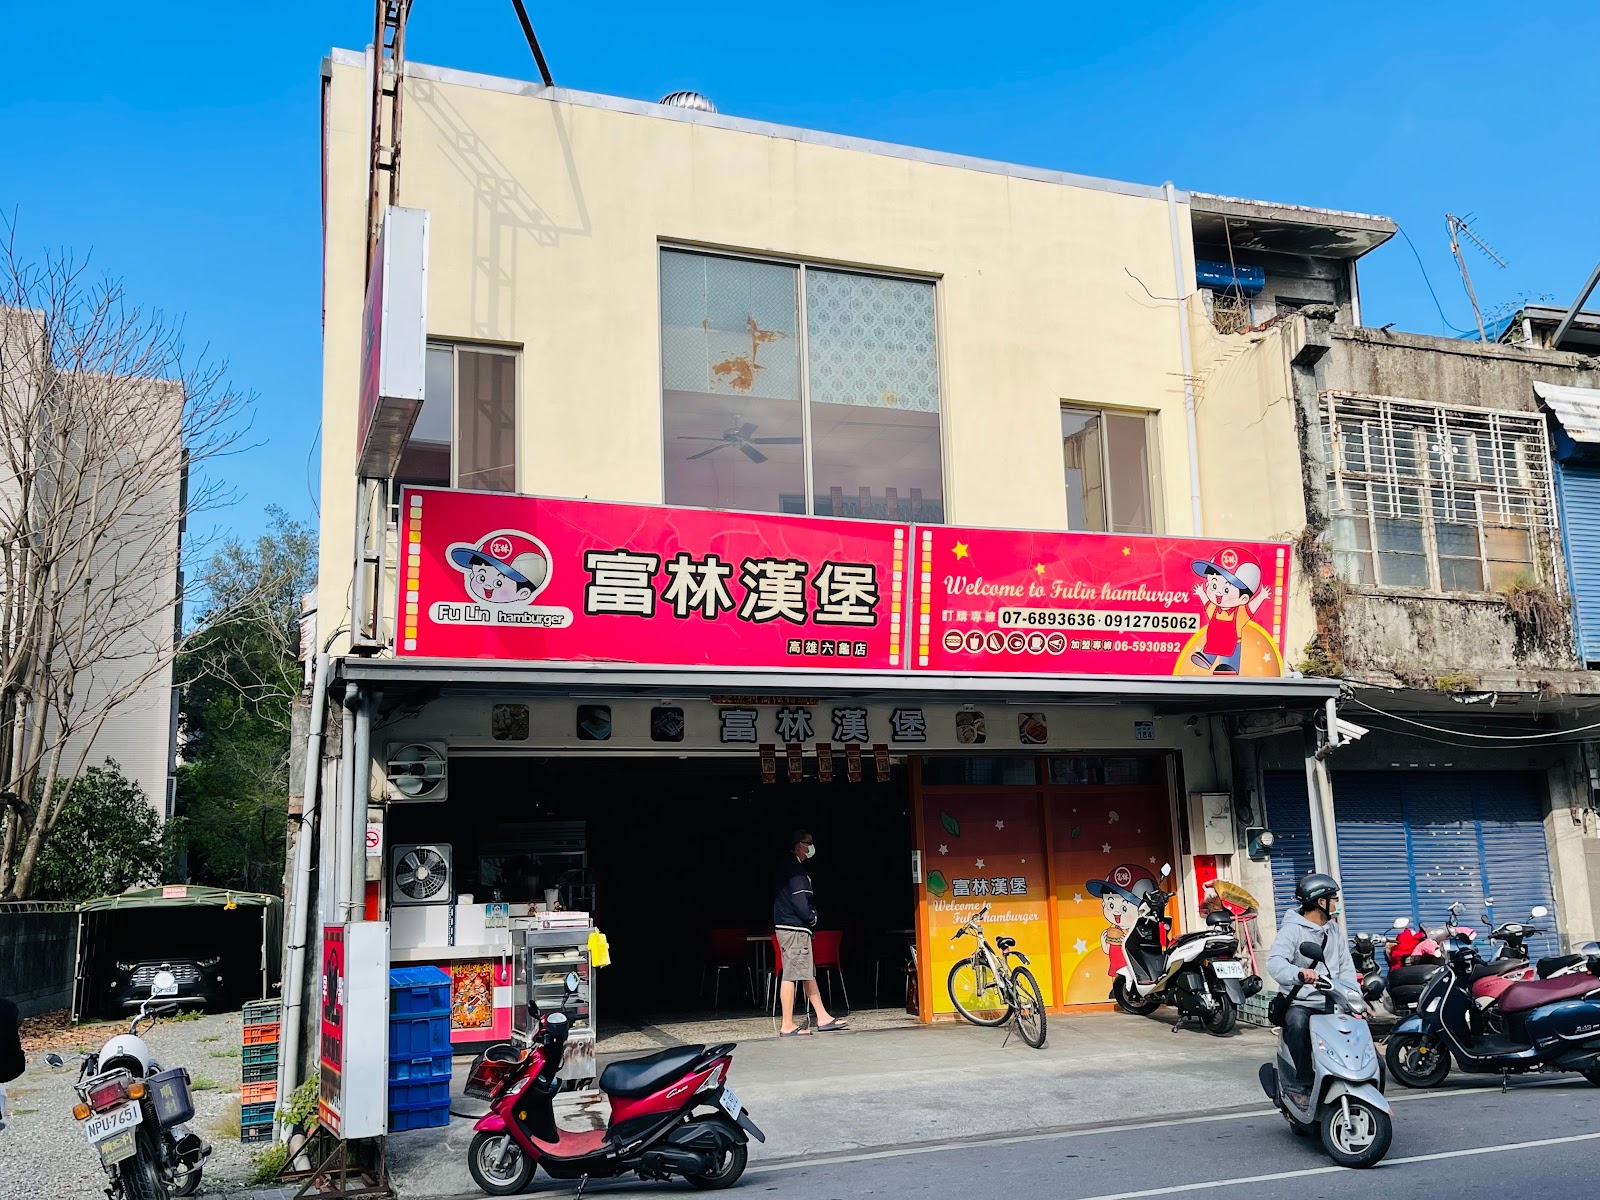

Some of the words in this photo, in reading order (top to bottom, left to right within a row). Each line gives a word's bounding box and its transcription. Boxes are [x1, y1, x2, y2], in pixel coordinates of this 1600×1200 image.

[584, 549, 881, 626] 富林漢堡
[943, 575, 1024, 598] Welcome
[1029, 580, 1045, 598] to
[1050, 580, 1097, 600] Fulin
[1101, 583, 1190, 608] hamburger
[436, 603, 460, 622] Fu
[464, 604, 491, 623] Lin
[497, 610, 565, 627] hamburger
[1114, 640, 1181, 653] 06-5930892
[719, 707, 927, 743] 富林漢堡
[1137, 731, 1152, 739] 184
[952, 877, 1028, 897] 富林漢堡
[933, 899, 980, 911] Welcome
[983, 910, 1039, 924] hamburger
[87, 1105, 138, 1138] NPU-7651
